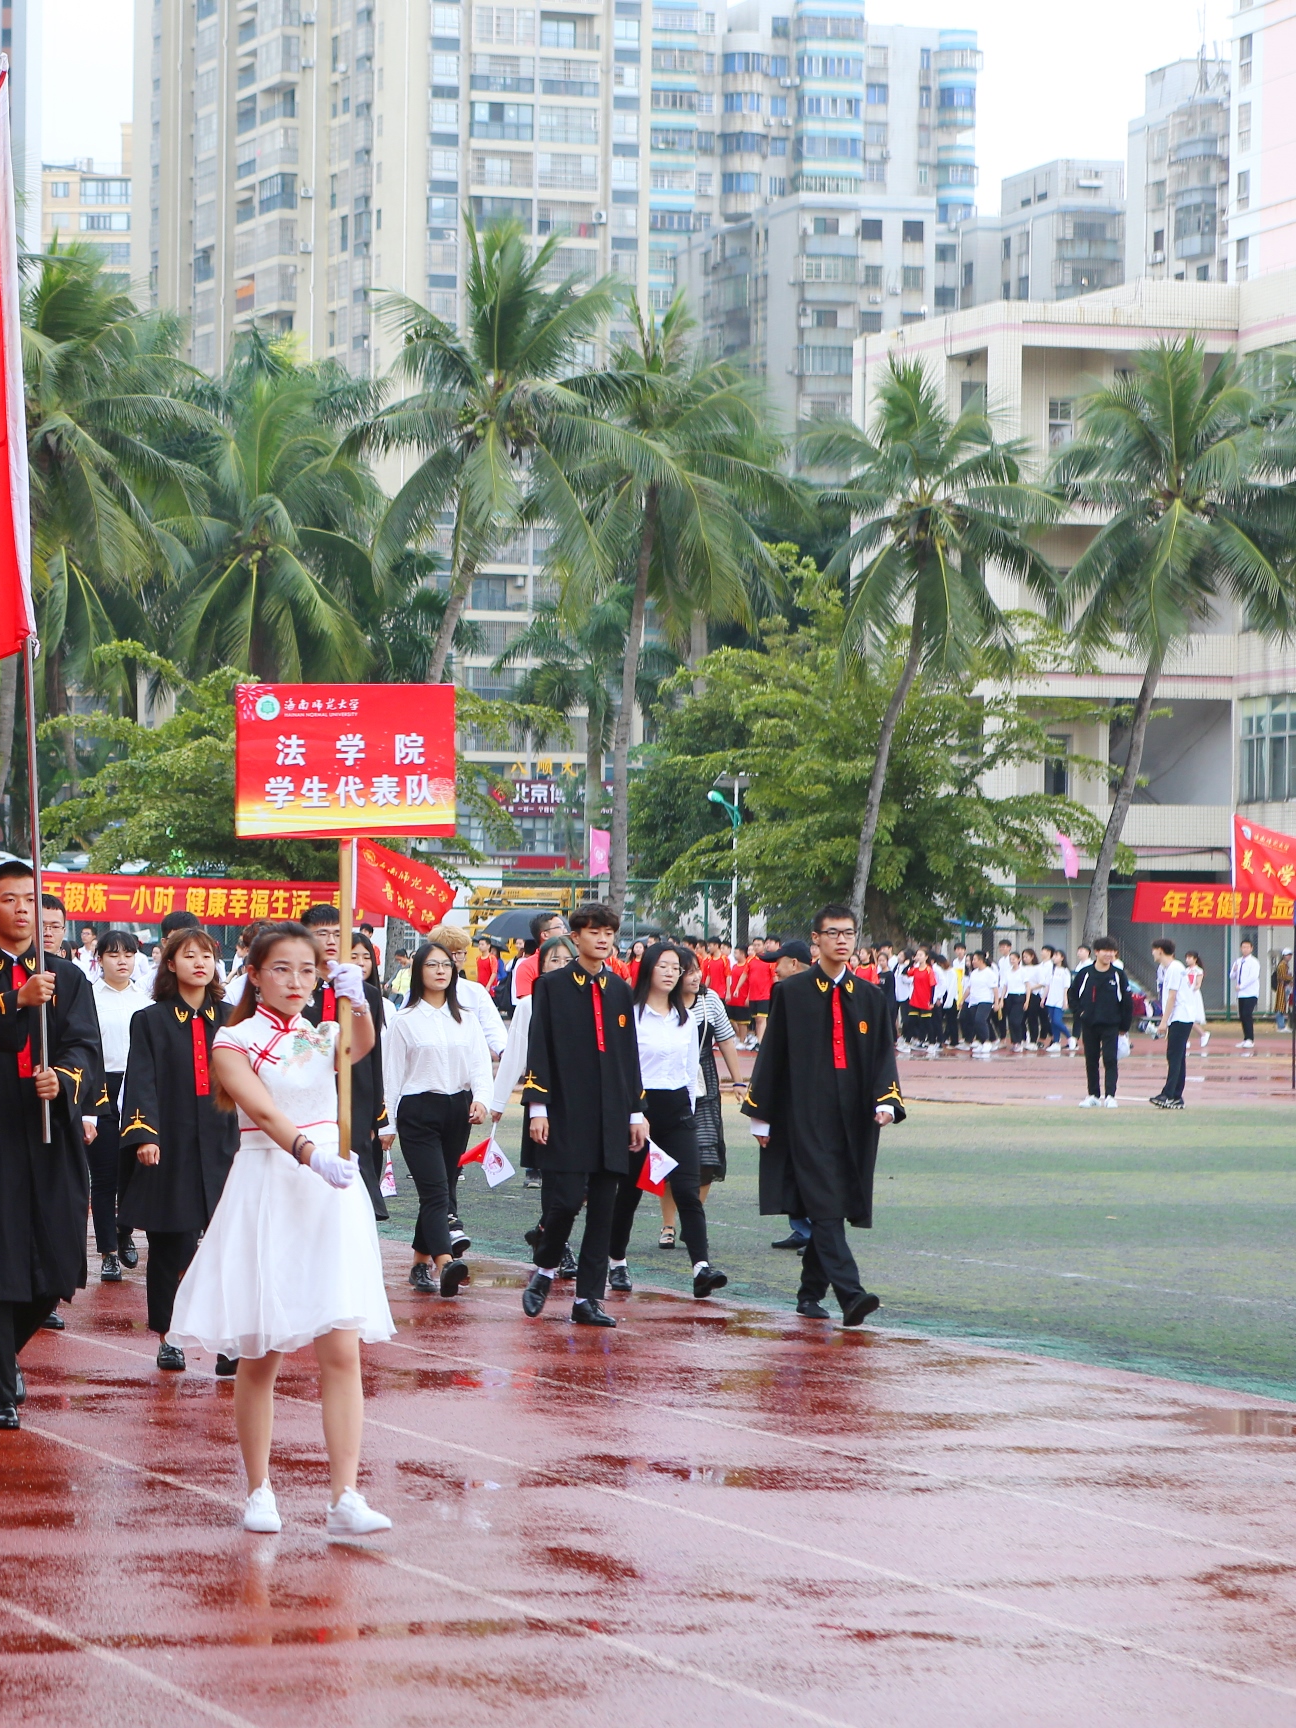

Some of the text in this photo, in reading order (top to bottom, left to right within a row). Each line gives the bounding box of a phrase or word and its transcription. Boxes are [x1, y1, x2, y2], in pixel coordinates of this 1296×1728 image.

[284, 698, 360, 712] 海南师范大学
[275, 733, 425, 767] 法学院
[264, 774, 436, 810] 学生代表队
[185, 886, 364, 921] 健康幸福生活一
[1160, 889, 1295, 920] 年轻健儿显
